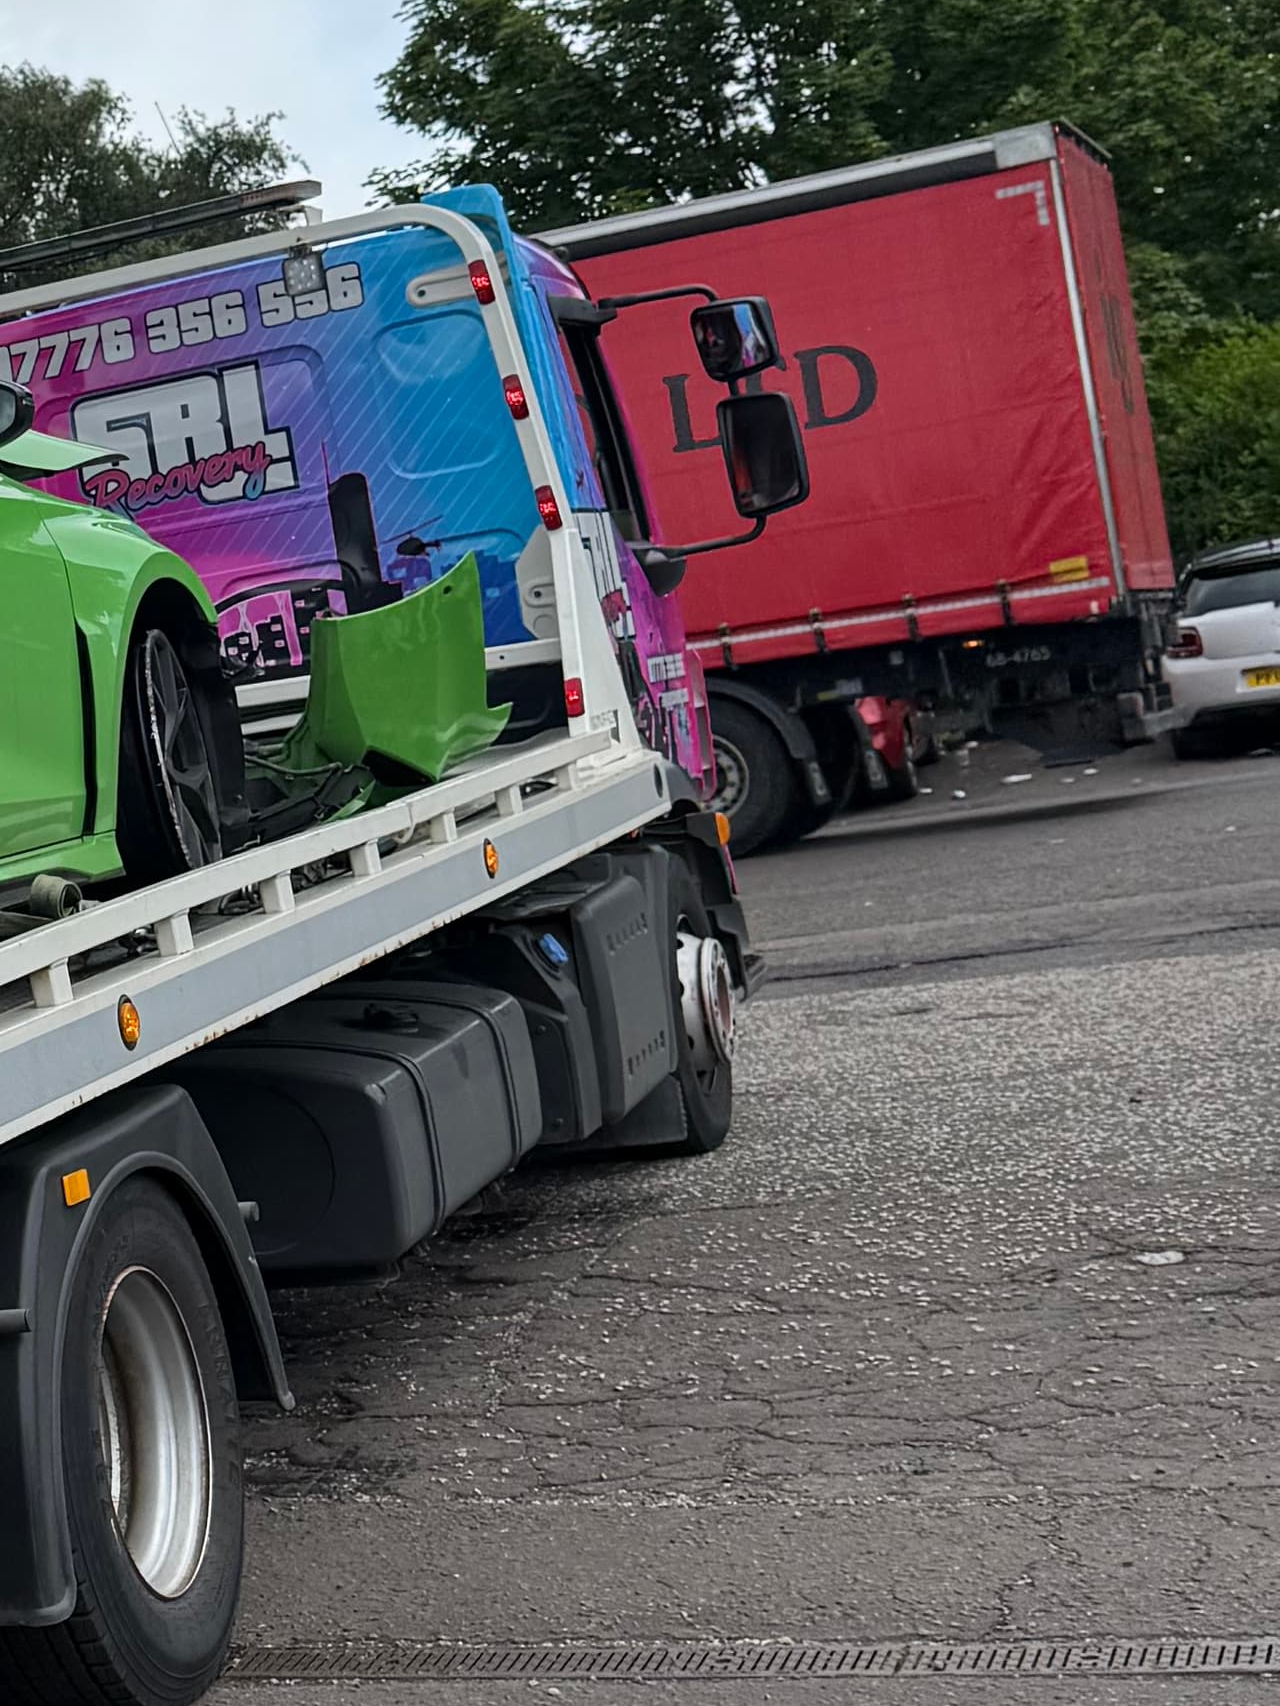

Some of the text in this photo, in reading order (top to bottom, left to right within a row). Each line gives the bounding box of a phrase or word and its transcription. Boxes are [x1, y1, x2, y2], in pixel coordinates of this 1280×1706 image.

[144, 289, 248, 355] 356
[662, 344, 878, 453] LD
[84, 440, 272, 522] Recovery
